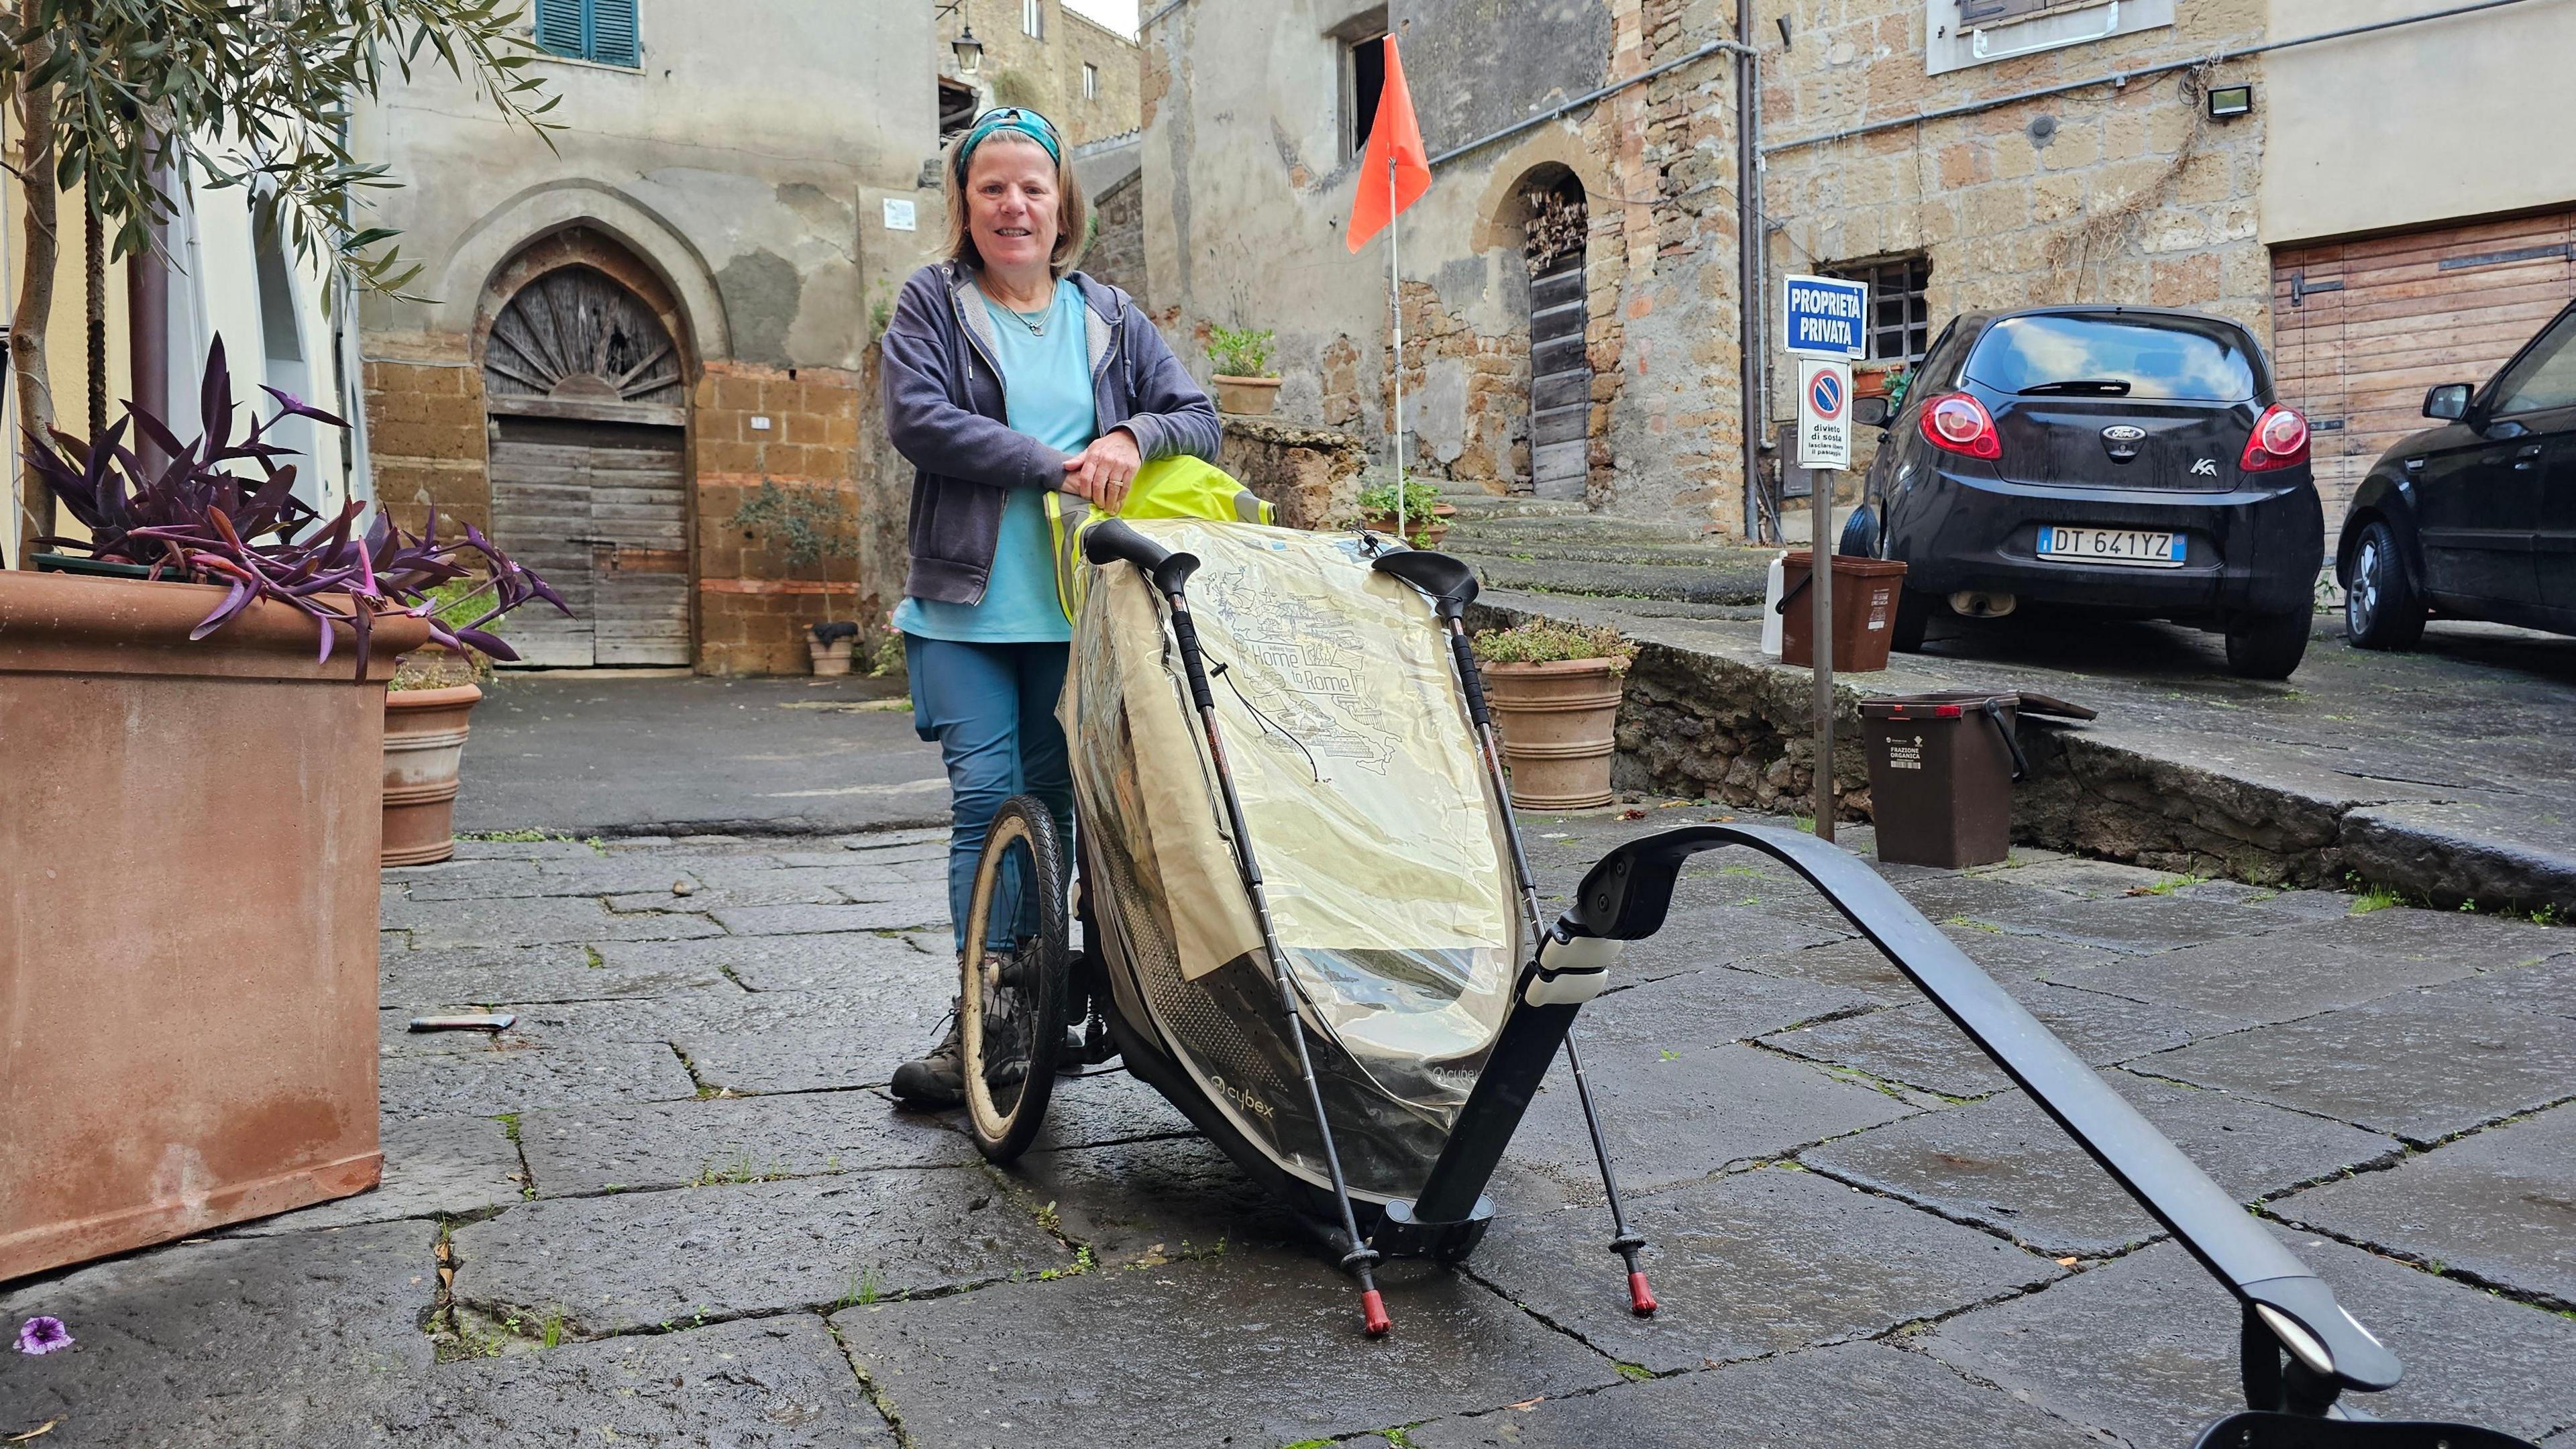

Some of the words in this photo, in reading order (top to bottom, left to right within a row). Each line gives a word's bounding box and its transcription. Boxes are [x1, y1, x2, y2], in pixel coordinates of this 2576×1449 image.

[1791, 288, 1861, 319] PROPRIETÀ
[1800, 317, 1852, 345] PRIVATA
[1814, 424, 1841, 433] divieto
[2112, 429, 2137, 438] Ford
[2055, 529, 2084, 552] DT
[2094, 532, 2170, 557] 641YZ
[1252, 645, 1299, 668] Home
[1291, 670, 1303, 684] to
[1304, 671, 1350, 692] Rome
[1228, 1087, 1274, 1118] cybex
